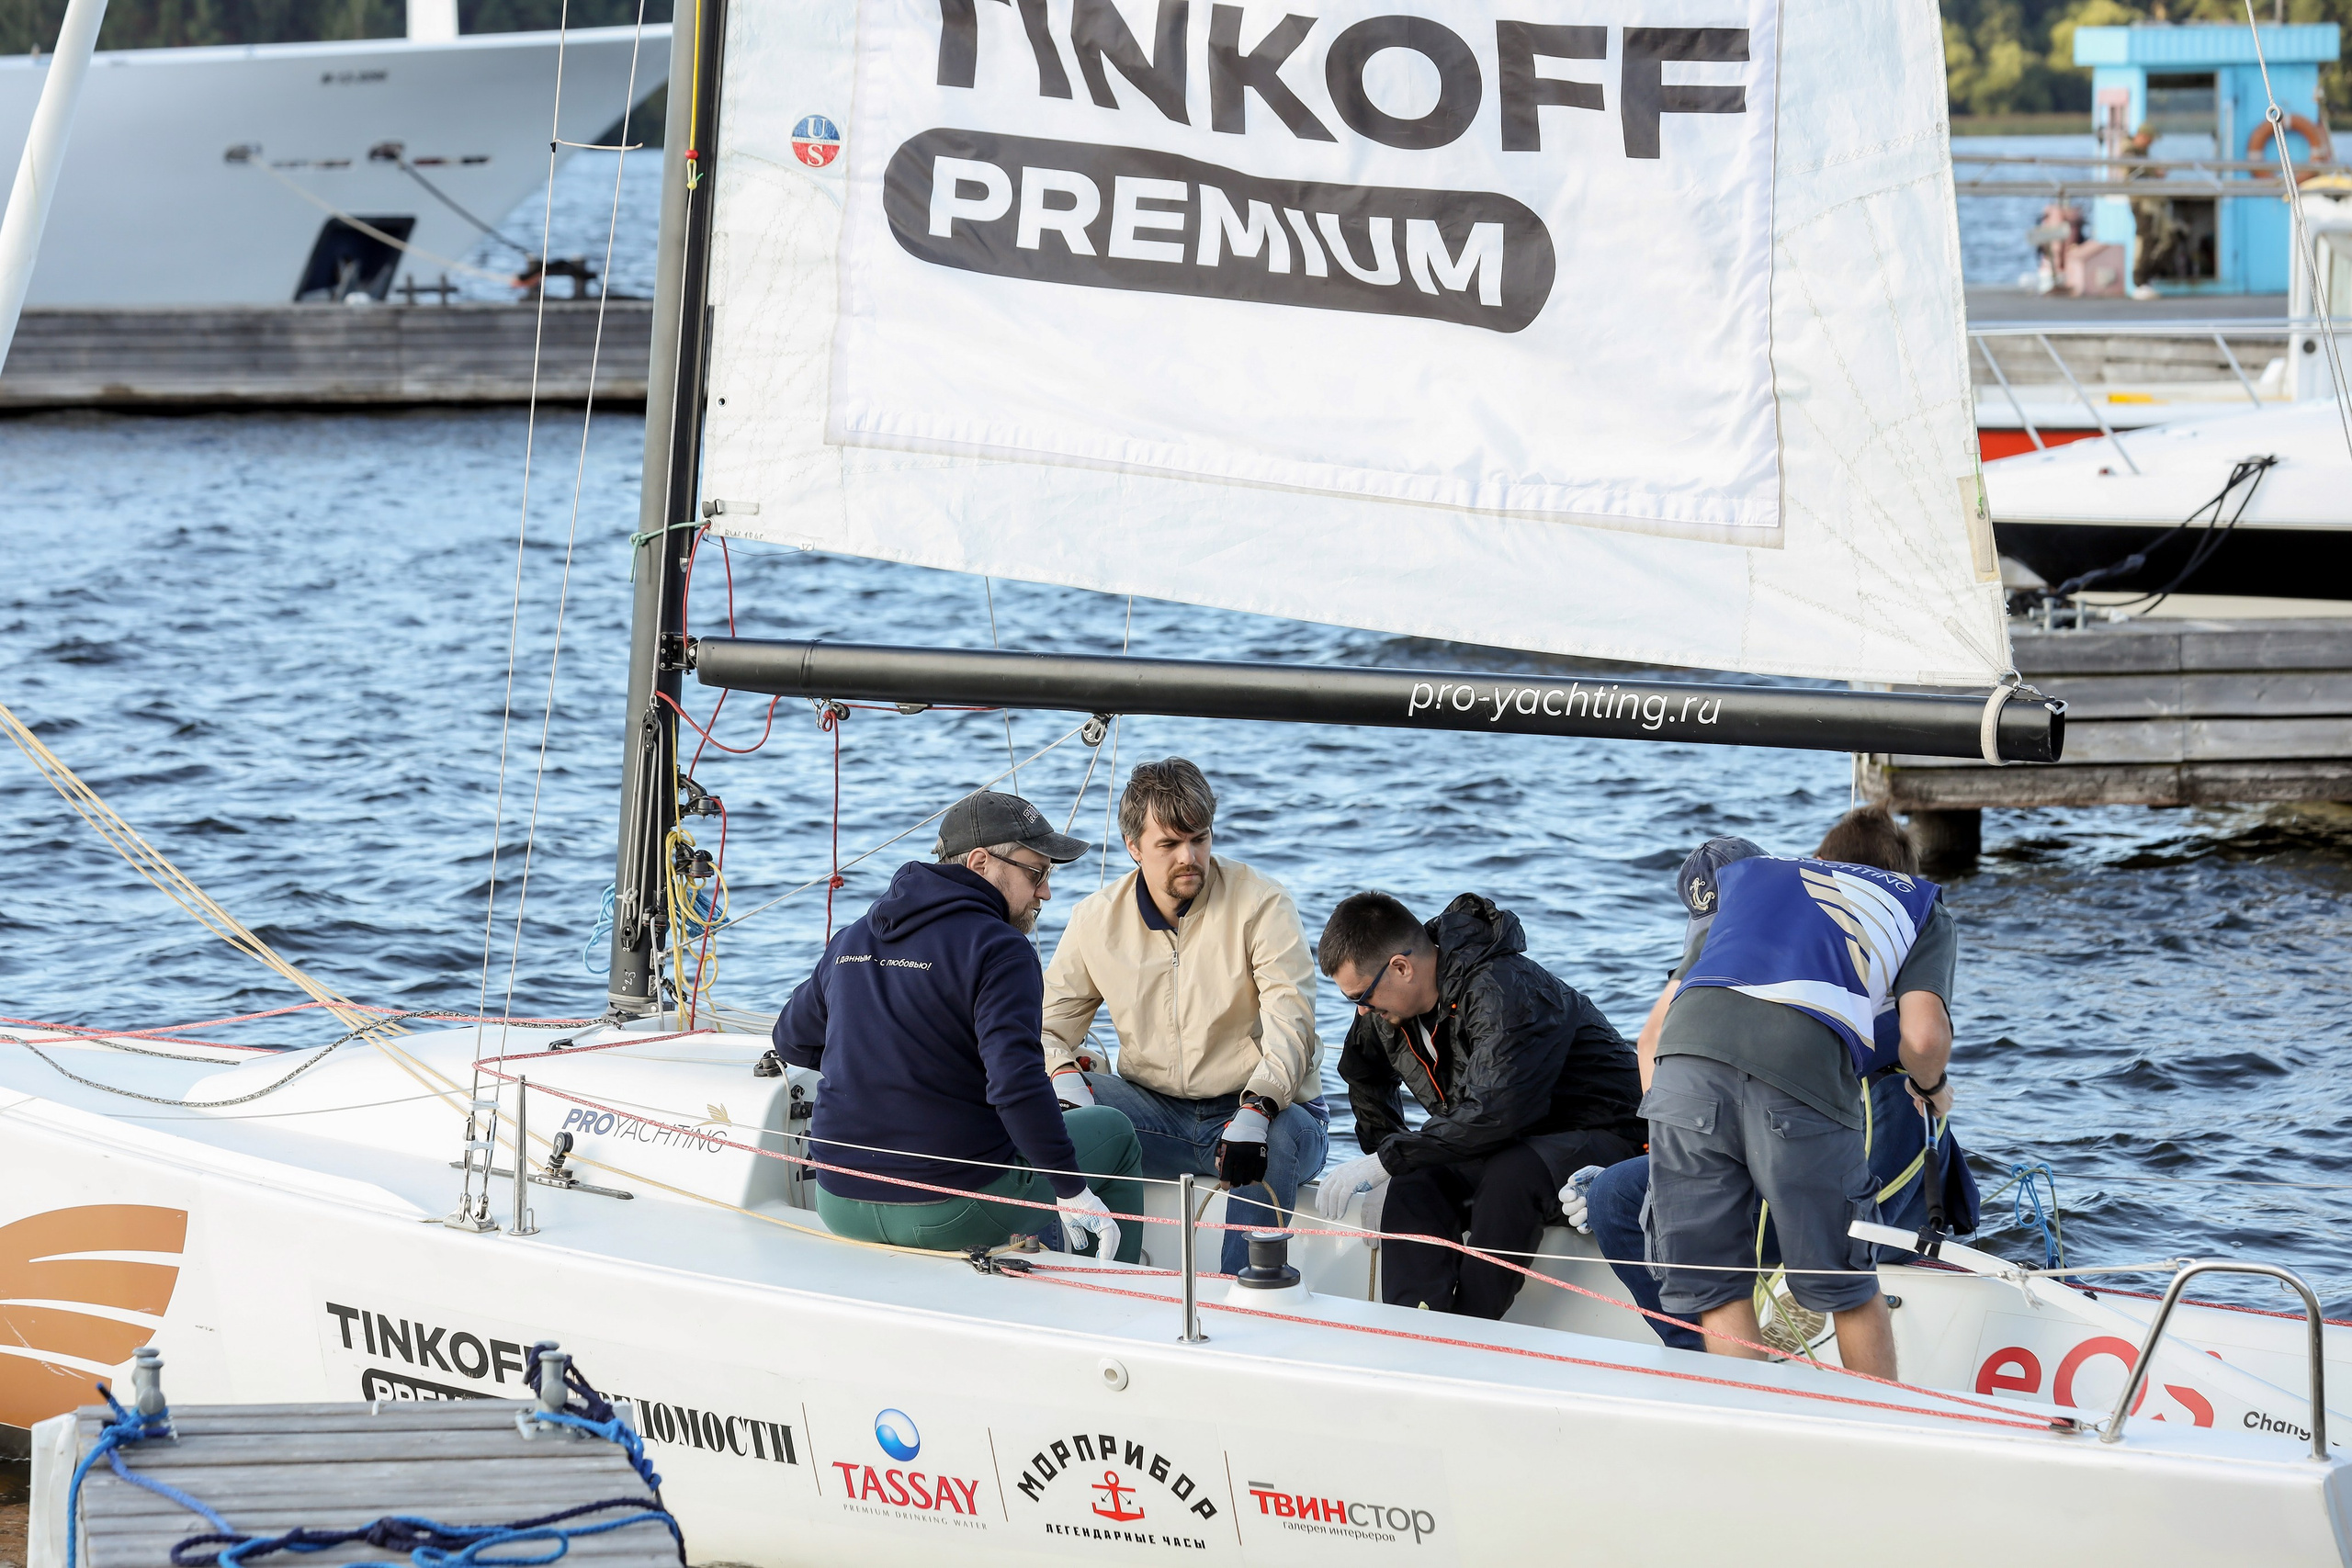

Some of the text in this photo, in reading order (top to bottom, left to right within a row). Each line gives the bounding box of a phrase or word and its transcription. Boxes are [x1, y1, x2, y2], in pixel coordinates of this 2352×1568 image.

[926, 154, 1506, 308] PREMIUM
[1408, 682, 1722, 731] pro-yachting.ru
[887, 958, 933, 971] любовью!
[326, 1302, 532, 1384] TINKOF
[597, 1392, 798, 1466] ДОМОСТИ
[2243, 1411, 2312, 1441] Chang
[831, 1461, 980, 1517] TASSAY
[1017, 1434, 1218, 1521] МОРПРИБОР
[842, 1503, 989, 1530] PREMIUM DRINKING WATER
[1046, 1523, 1207, 1550] ЛЕГЕНДАРНЫЕ ЧАСЫ
[1283, 1521, 1396, 1543] галерея интерьеров
